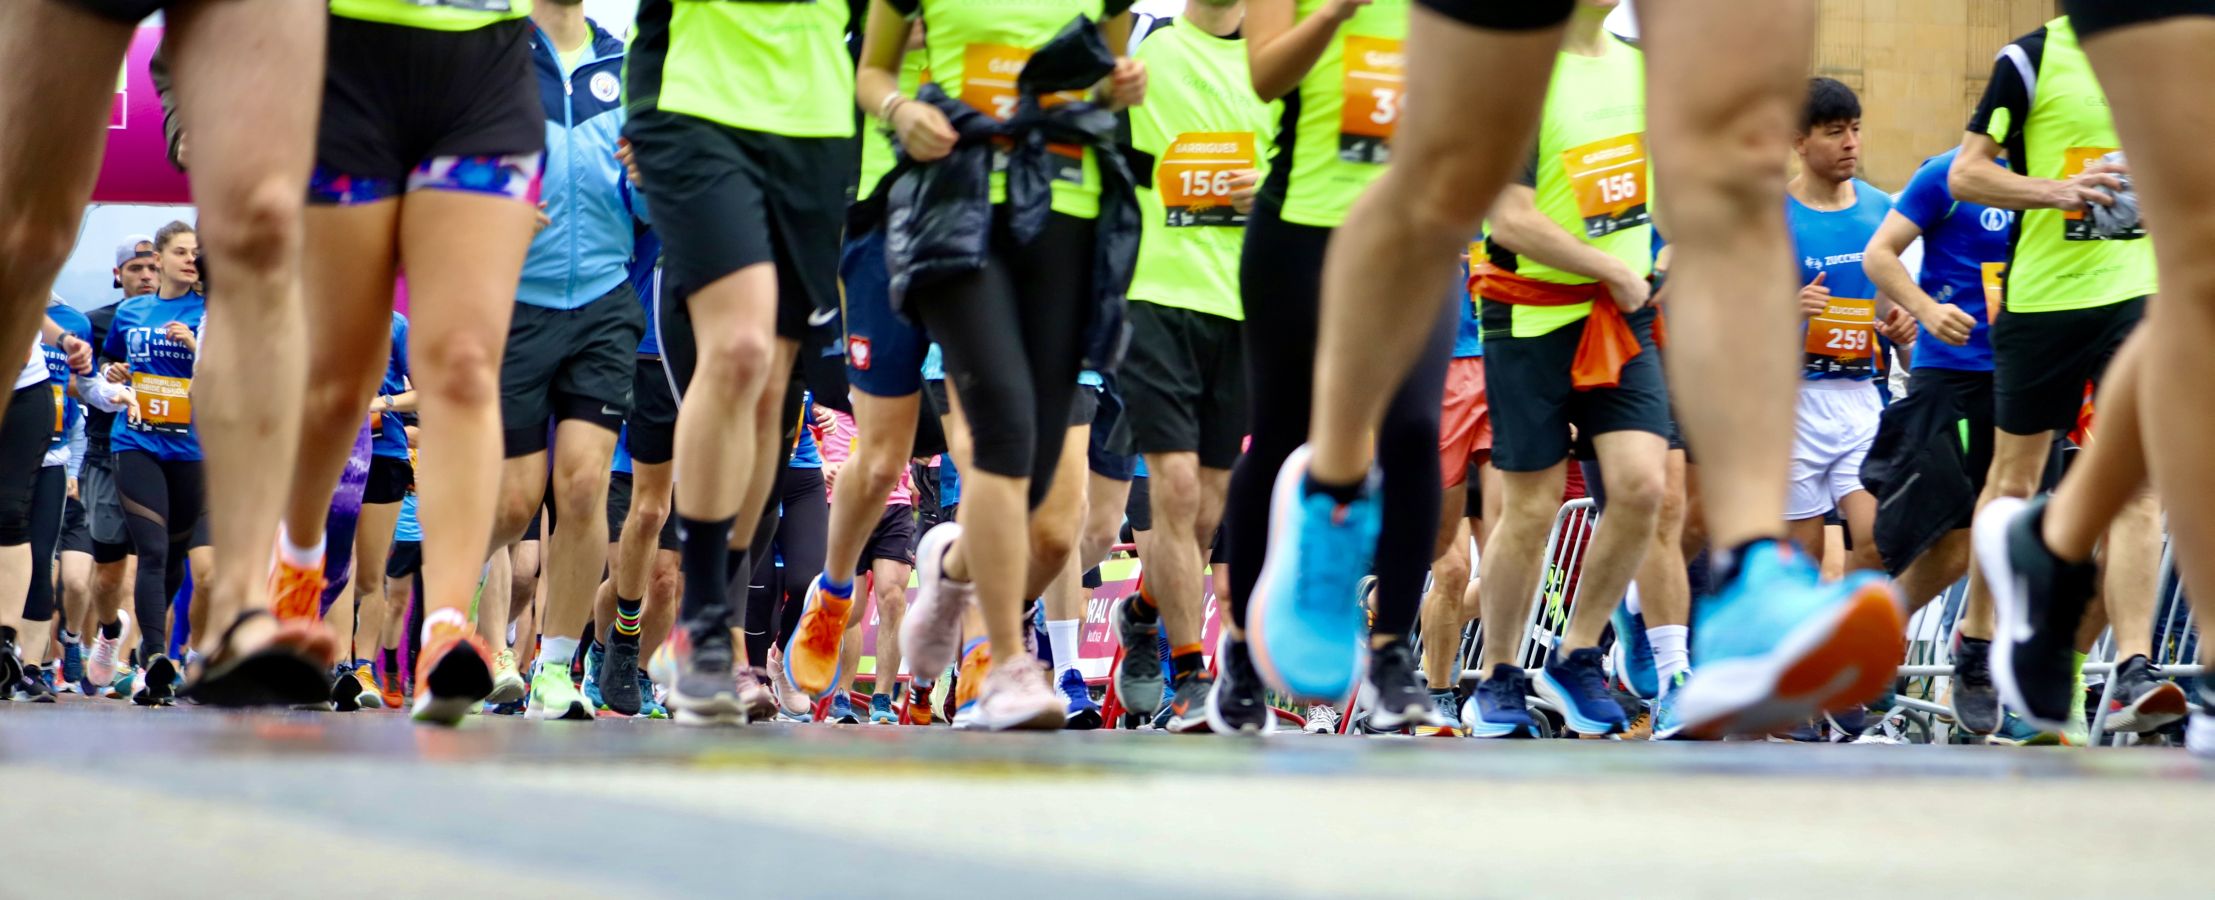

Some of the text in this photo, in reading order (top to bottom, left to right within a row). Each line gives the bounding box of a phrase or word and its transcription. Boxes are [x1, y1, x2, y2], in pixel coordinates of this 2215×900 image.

[1370, 88, 1408, 124] 3
[1175, 142, 1238, 153] GARRIGUES
[1179, 170, 1231, 196] 156
[1597, 172, 1637, 203] 156
[1826, 328, 1868, 350] 259
[149, 399, 170, 416] 51
[1086, 598, 1109, 623] RAL
